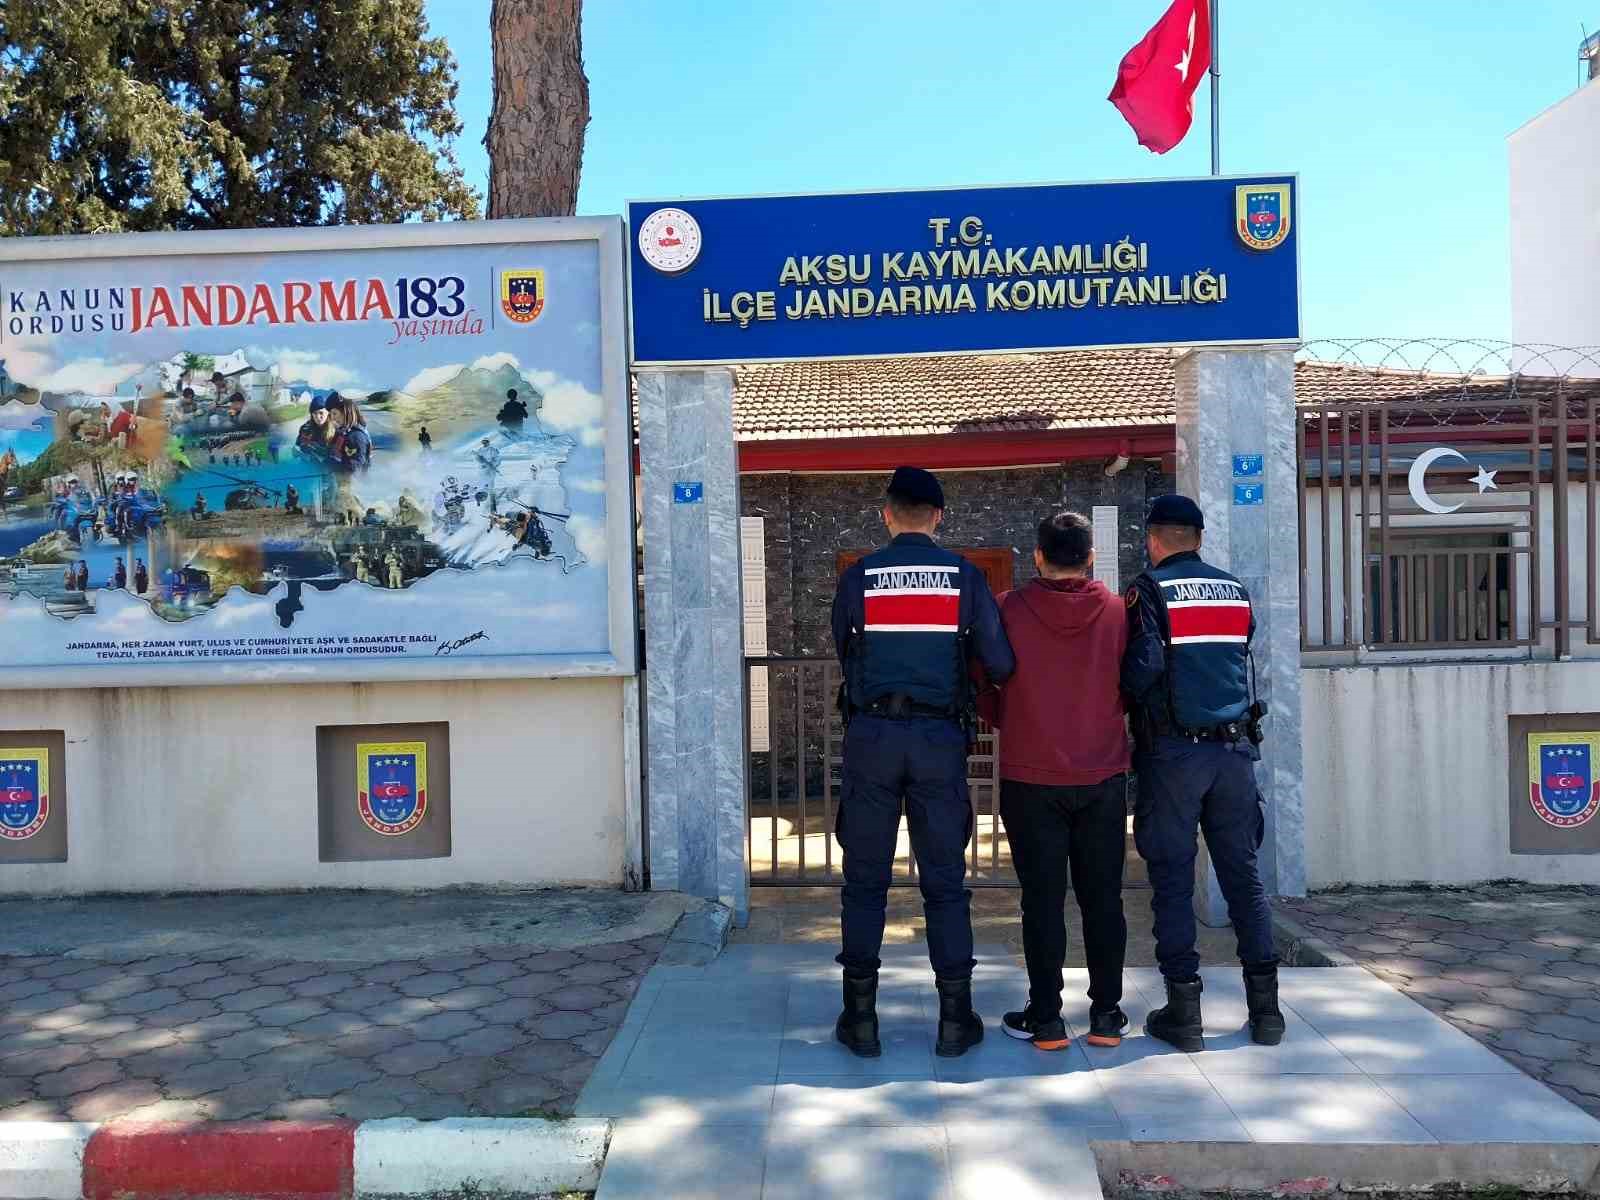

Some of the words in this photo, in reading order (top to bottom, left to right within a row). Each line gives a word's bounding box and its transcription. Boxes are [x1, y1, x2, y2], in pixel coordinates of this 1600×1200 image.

[928, 216, 993, 247] T.C.
[779, 254, 871, 286] AKSU
[882, 235, 1148, 281] KAYMAKAMLIĞI
[9, 288, 125, 313] KANUN
[130, 278, 394, 334] JANDARMA
[395, 276, 466, 320] 183
[702, 288, 777, 328] İLÇE
[785, 283, 977, 320] JANDARMA
[986, 268, 1228, 313] KOMUTANLIĞI
[9, 313, 125, 336] ORDUSU
[387, 309, 485, 345] yaşında
[686, 488, 692, 497] 8
[1245, 489, 1252, 499] 6
[873, 571, 953, 589] JANDARMA
[1173, 583, 1243, 600] JANDARMA
[66, 641, 120, 650] JANDARMA,
[122, 641, 141, 649] HER
[143, 640, 176, 648] ZAMAN
[178, 640, 205, 649] YURT,
[206, 639, 232, 647] ULUS
[233, 638, 246, 646] VE
[247, 636, 314, 646] CUMHURİYETE
[316, 637, 336, 646] AŞK
[337, 637, 350, 645] VE
[352, 635, 407, 644] SADAKATLE
[409, 634, 438, 643] BAĞLI
[96, 650, 136, 659] TEVAZU,
[197, 649, 210, 657] VE
[211, 648, 253, 656] FERAGAT
[293, 645, 309, 655] BİR
[311, 646, 344, 654] KANUN
